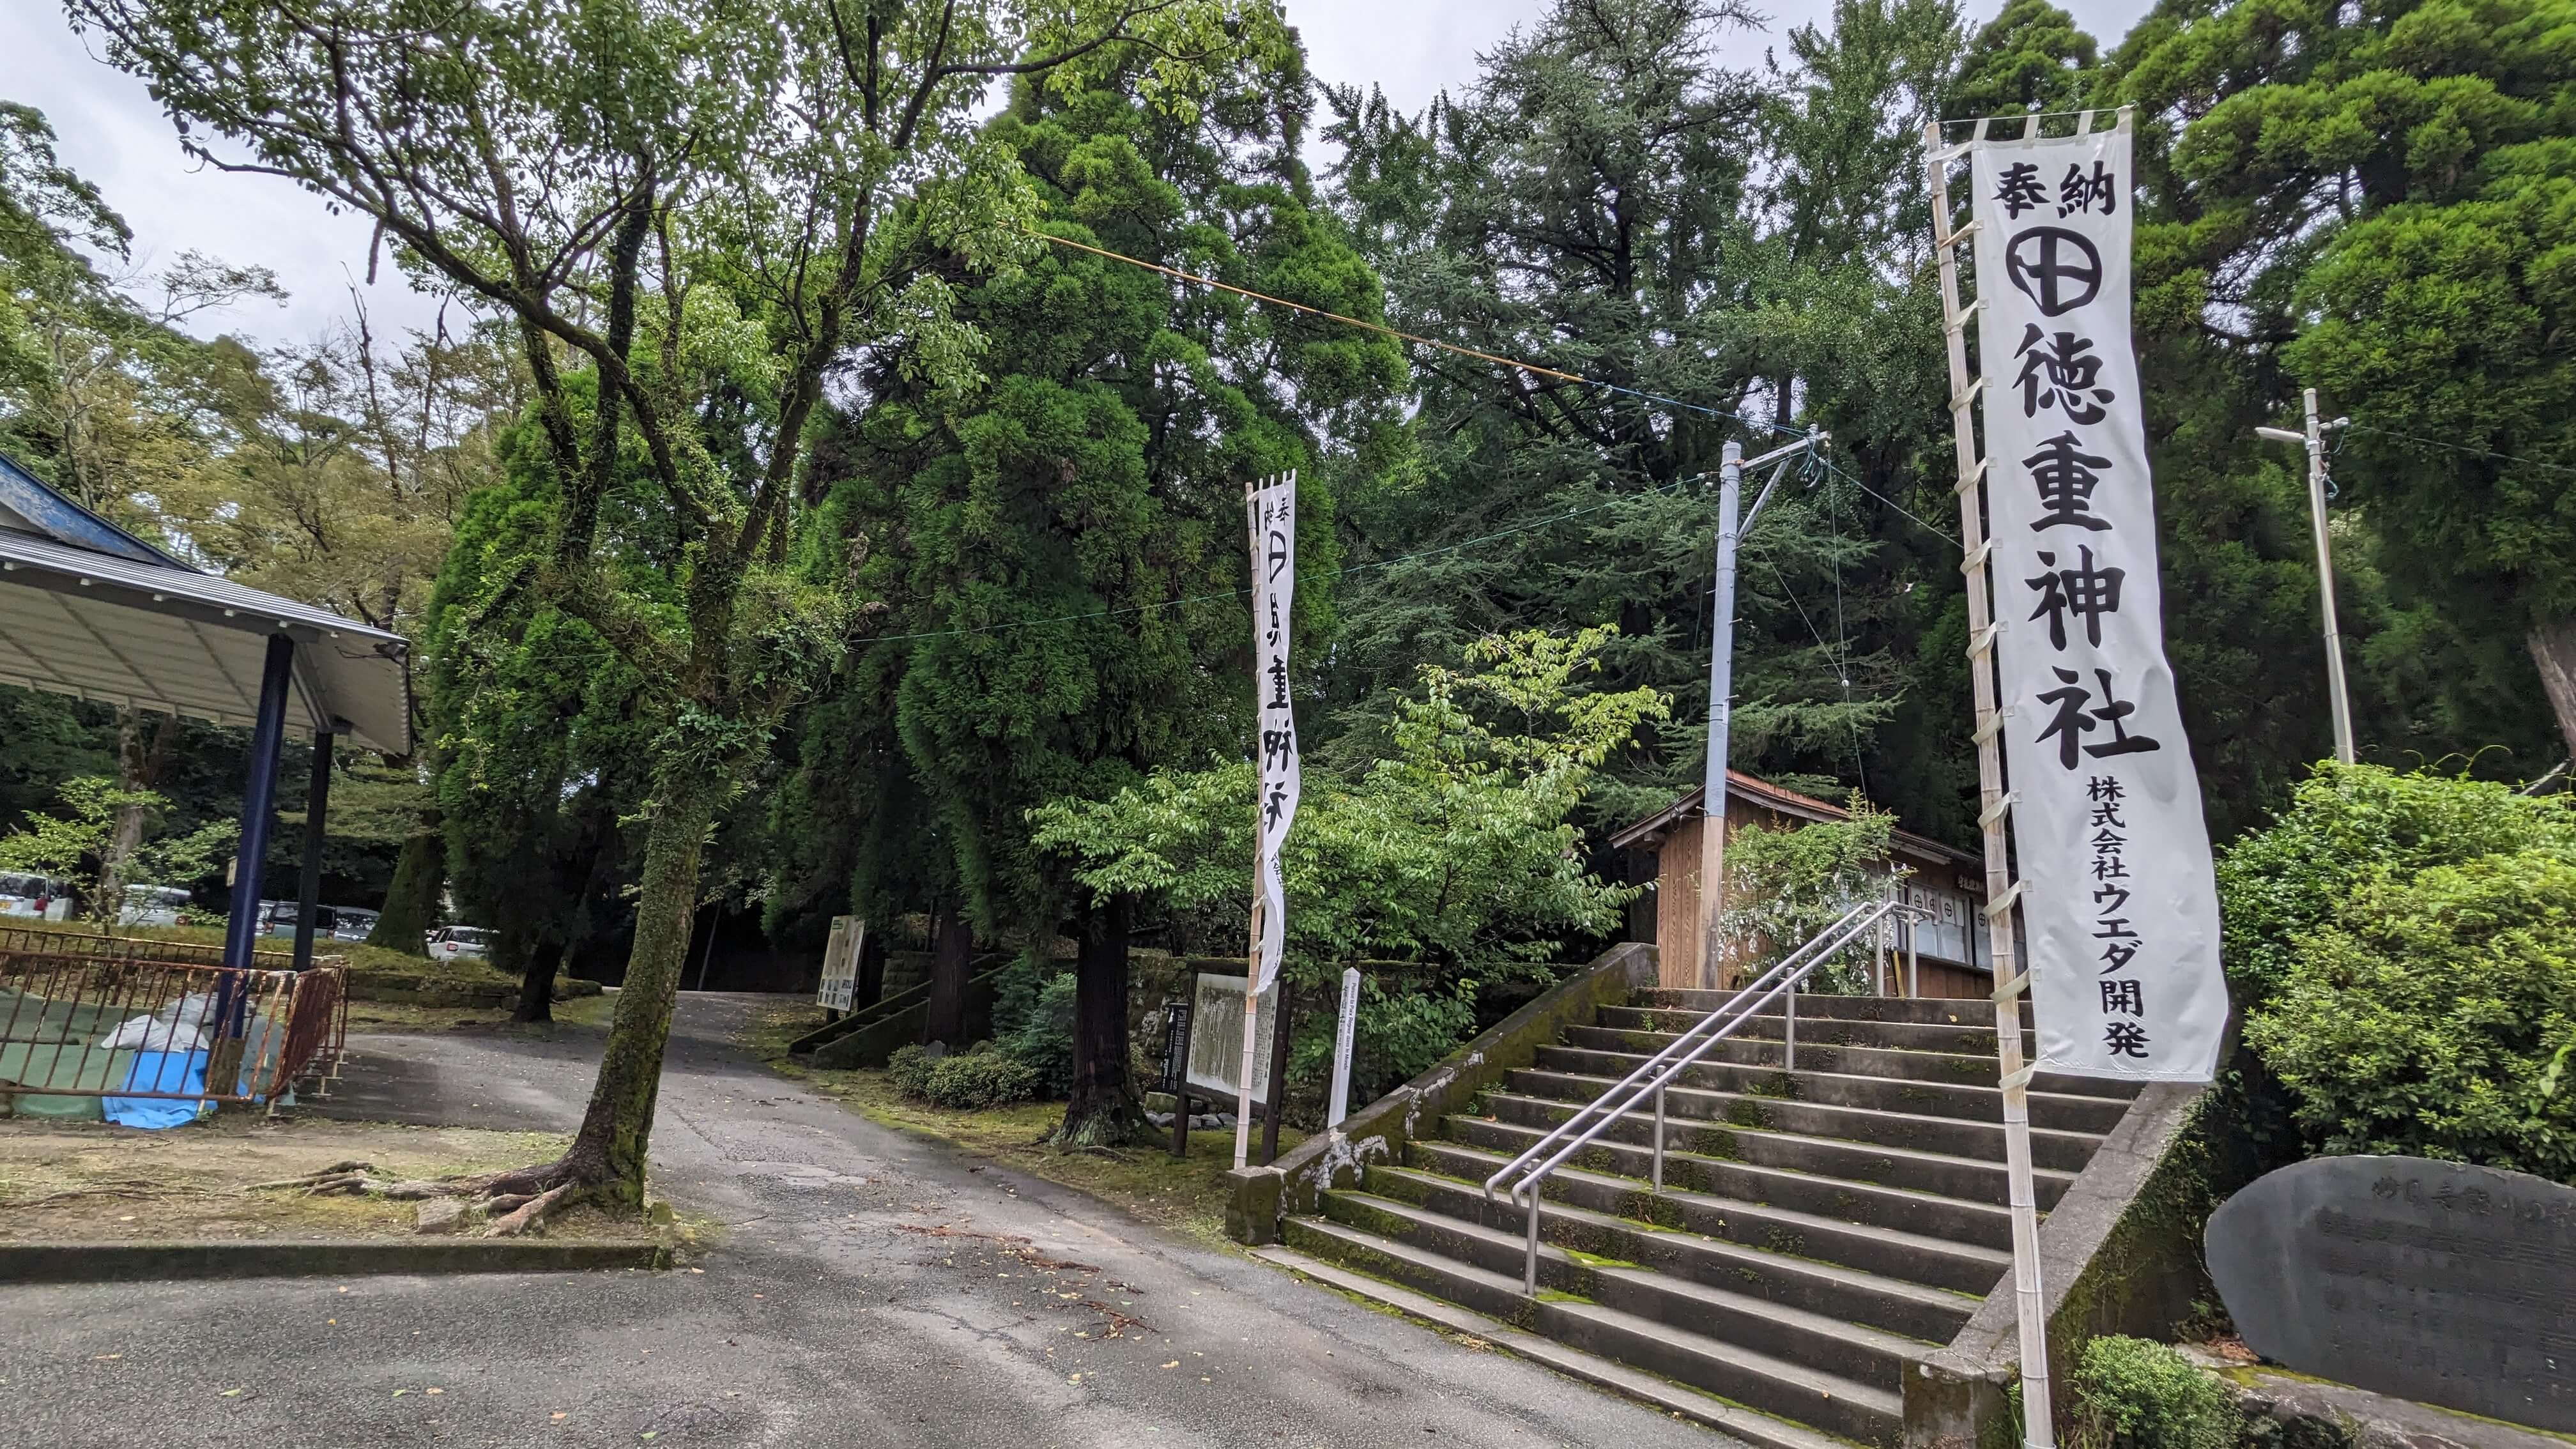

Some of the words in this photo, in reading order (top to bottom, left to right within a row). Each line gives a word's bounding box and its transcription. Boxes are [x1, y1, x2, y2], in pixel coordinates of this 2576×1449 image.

[1991, 160, 2115, 218] 奉納
[2012, 322, 2161, 770] 徳重神社
[2086, 776, 2152, 1058] 株式会社ウエダ開発
